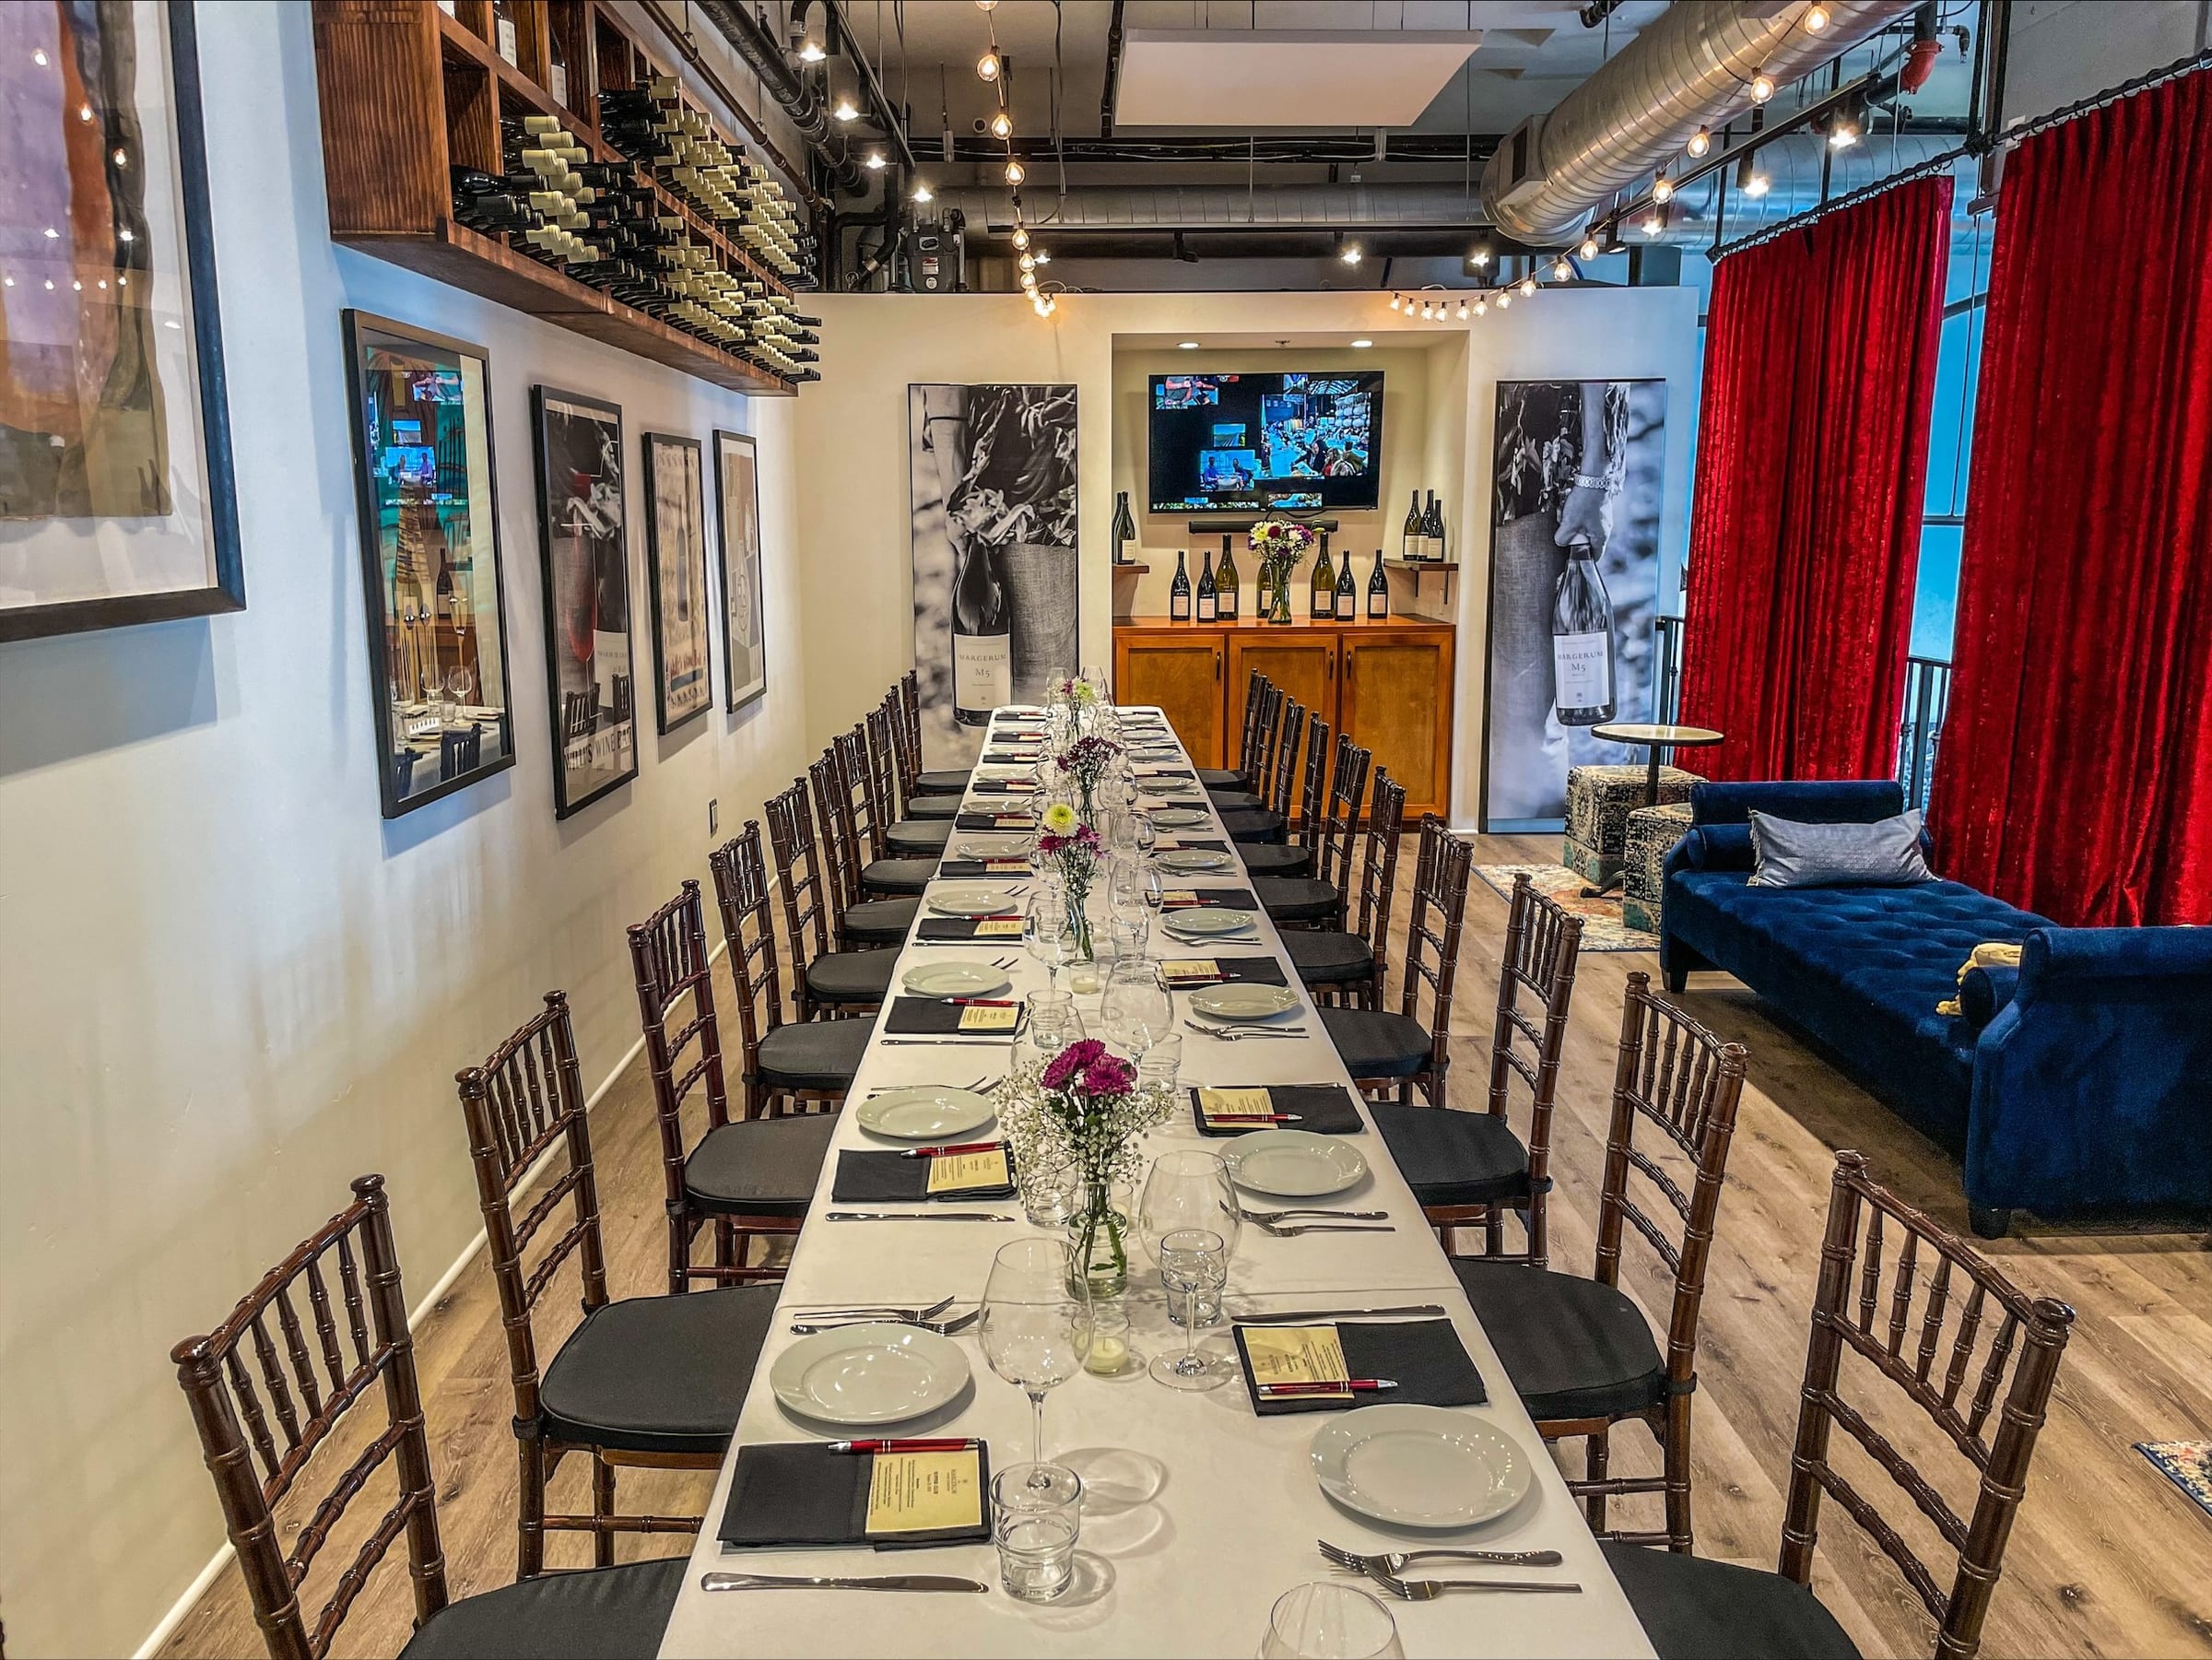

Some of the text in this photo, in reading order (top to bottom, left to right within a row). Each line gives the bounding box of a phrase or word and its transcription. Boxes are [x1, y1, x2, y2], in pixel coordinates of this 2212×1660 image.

[959, 653, 1006, 662] MARGERUM
[1558, 650, 1604, 660] MARGERUM
[1571, 663, 1586, 672] M5
[975, 668, 991, 677] M5
[594, 733, 615, 757] WINE
[617, 726, 632, 749] BAR
